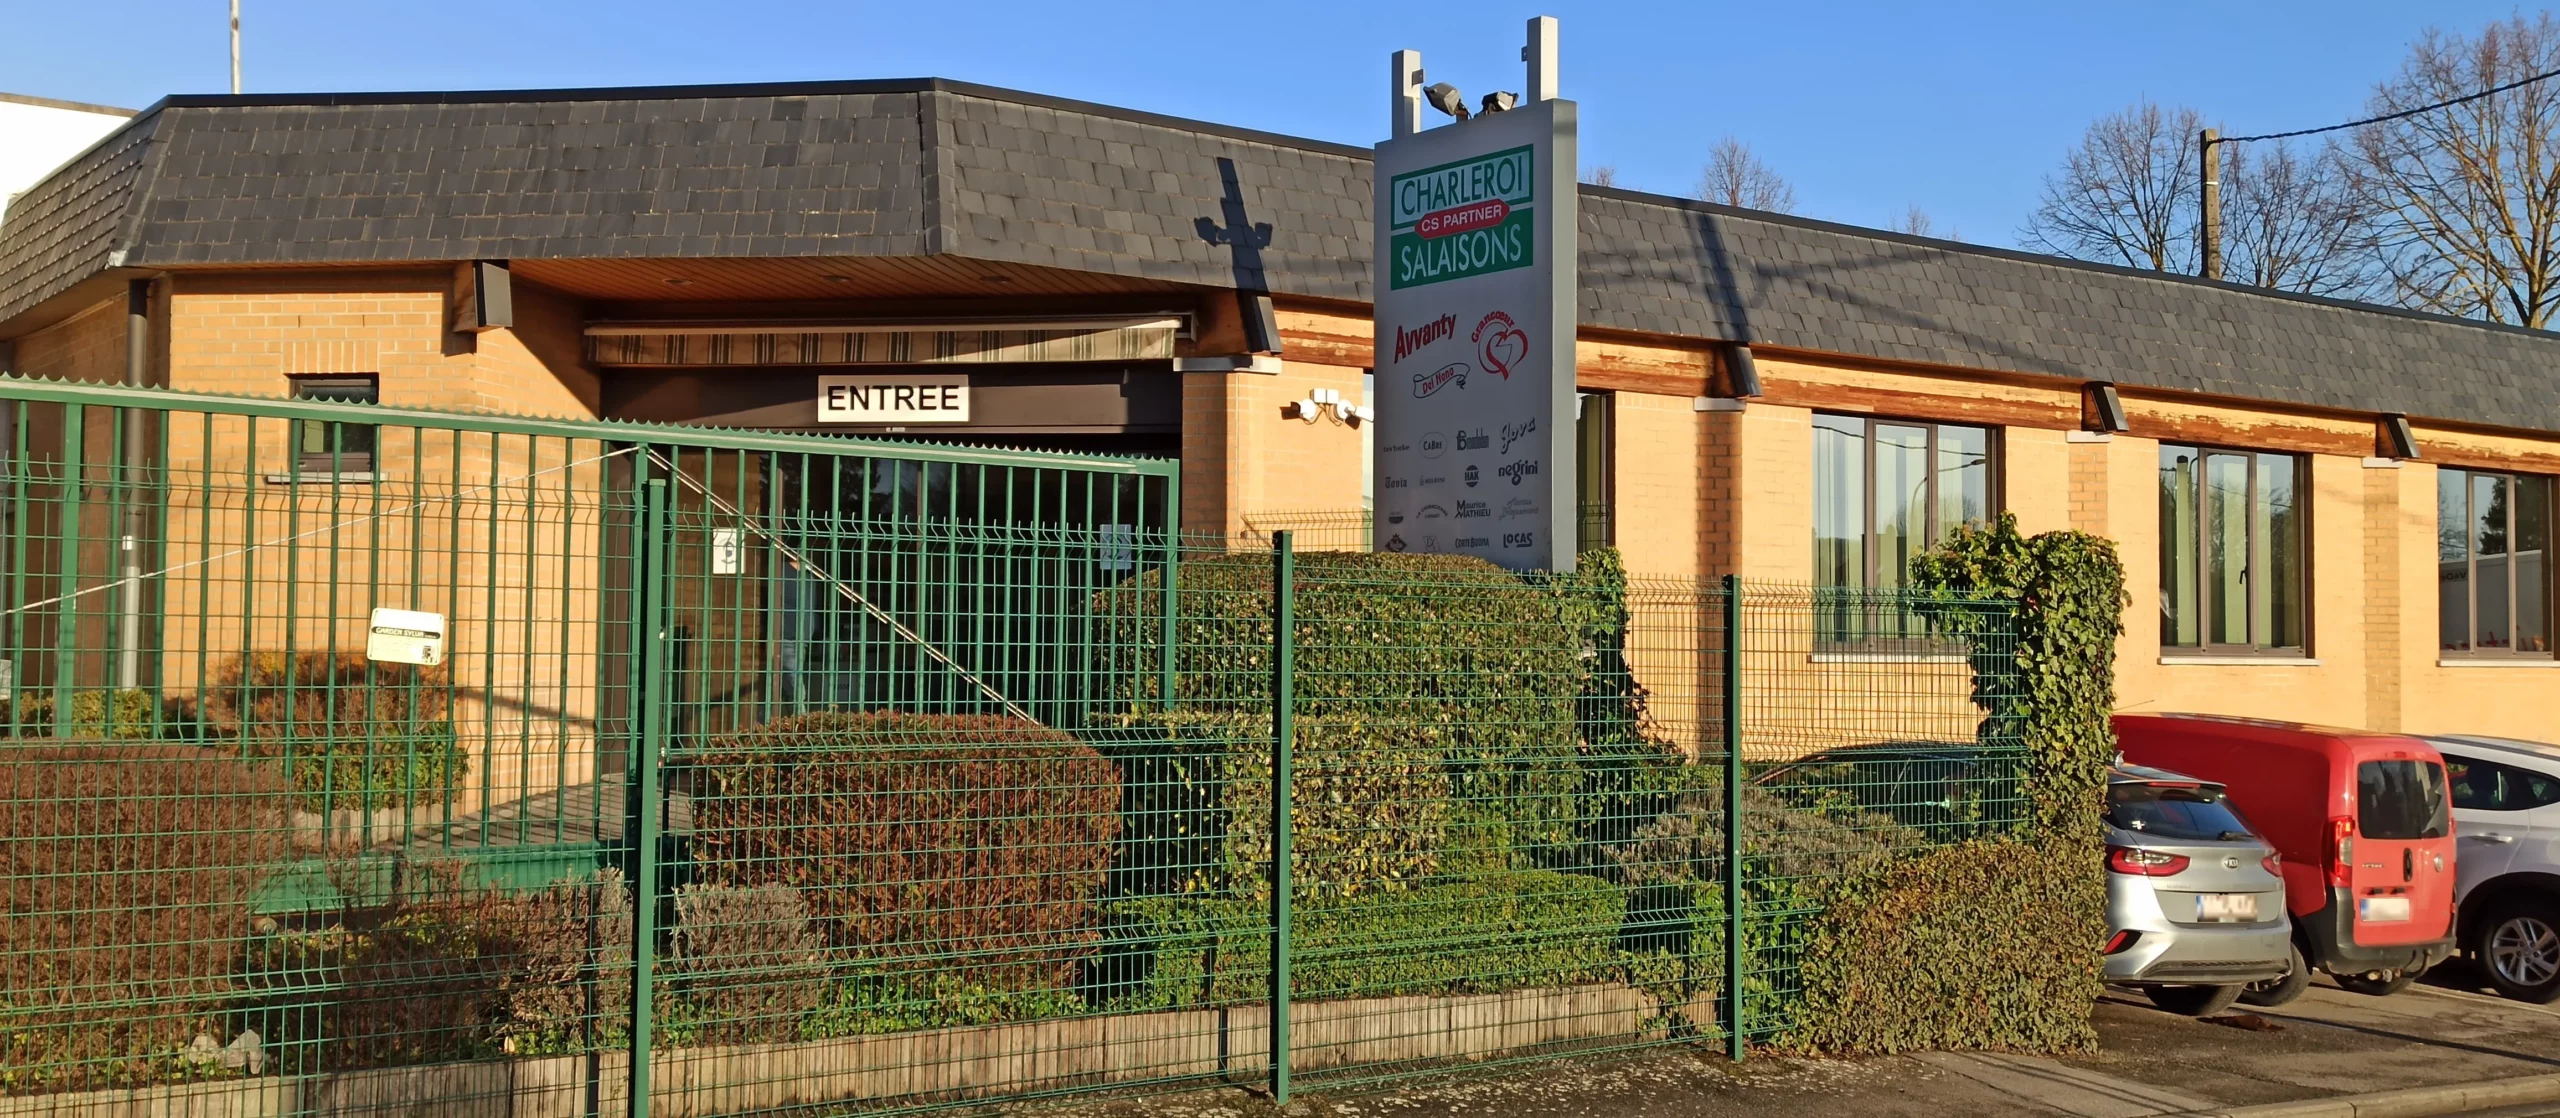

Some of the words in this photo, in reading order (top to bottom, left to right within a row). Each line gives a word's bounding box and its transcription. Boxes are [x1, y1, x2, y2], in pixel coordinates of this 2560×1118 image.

[1401, 155, 1522, 216] CHARLEROI
[1421, 219, 1439, 232] CS
[1443, 204, 1502, 228] PARTNER
[1401, 223, 1521, 282] SALAISONS
[1394, 313, 1457, 364] Avvanty
[827, 385, 960, 411] ENTREE
[1422, 380, 1435, 395] Del
[1498, 459, 1538, 486] negrini
[1454, 508, 1491, 519] MATHIEU
[1456, 500, 1487, 510] Maurice
[1503, 532, 1533, 548] LOCAS
